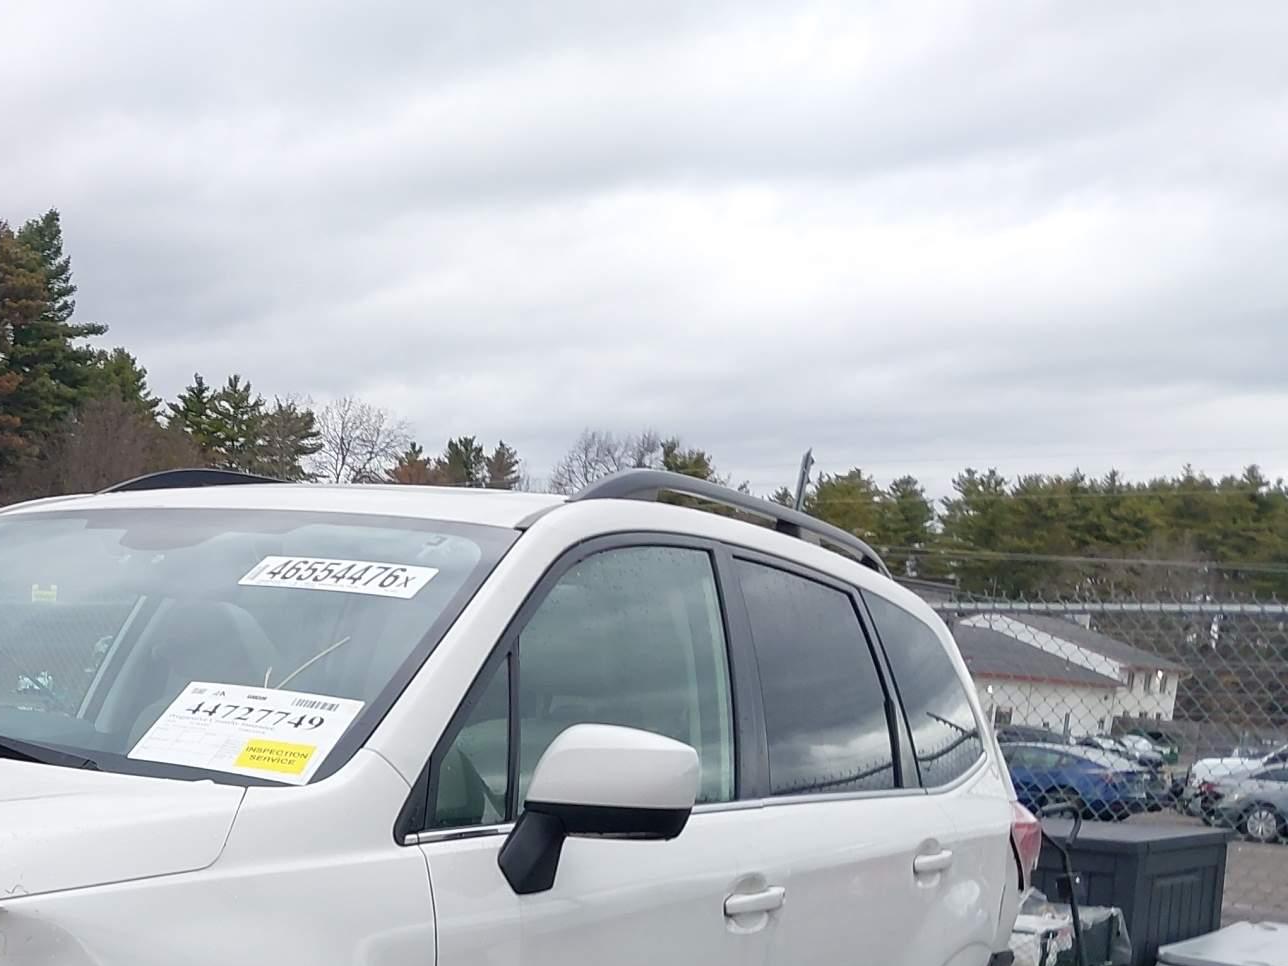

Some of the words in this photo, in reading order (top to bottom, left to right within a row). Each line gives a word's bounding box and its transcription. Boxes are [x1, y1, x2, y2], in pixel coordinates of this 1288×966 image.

[185, 701, 325, 731] 44727749
[245, 745, 309, 760] INSPECTION
[249, 754, 297, 766] SERVICE
